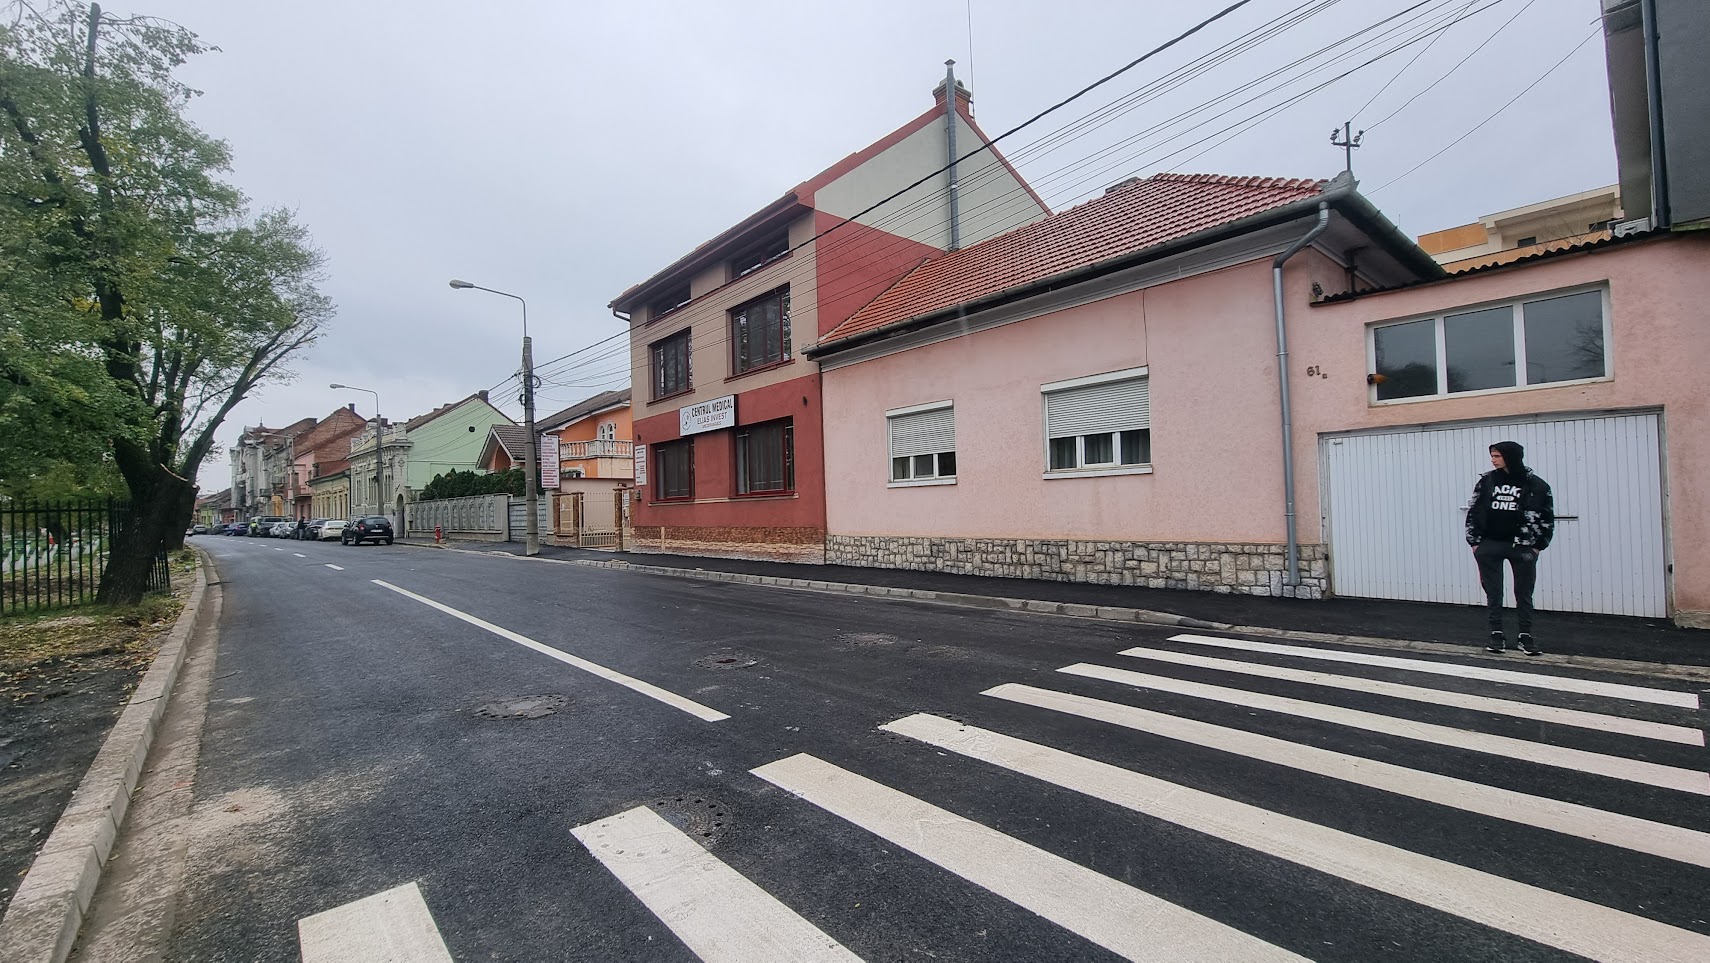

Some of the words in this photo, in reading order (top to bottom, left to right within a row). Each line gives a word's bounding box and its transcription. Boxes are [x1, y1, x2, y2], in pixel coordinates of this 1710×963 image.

[691, 404, 711, 418] CENTRUL
[712, 398, 733, 412] MEDICAL
[697, 415, 710, 425] ELIAS
[711, 411, 727, 422] INVEST
